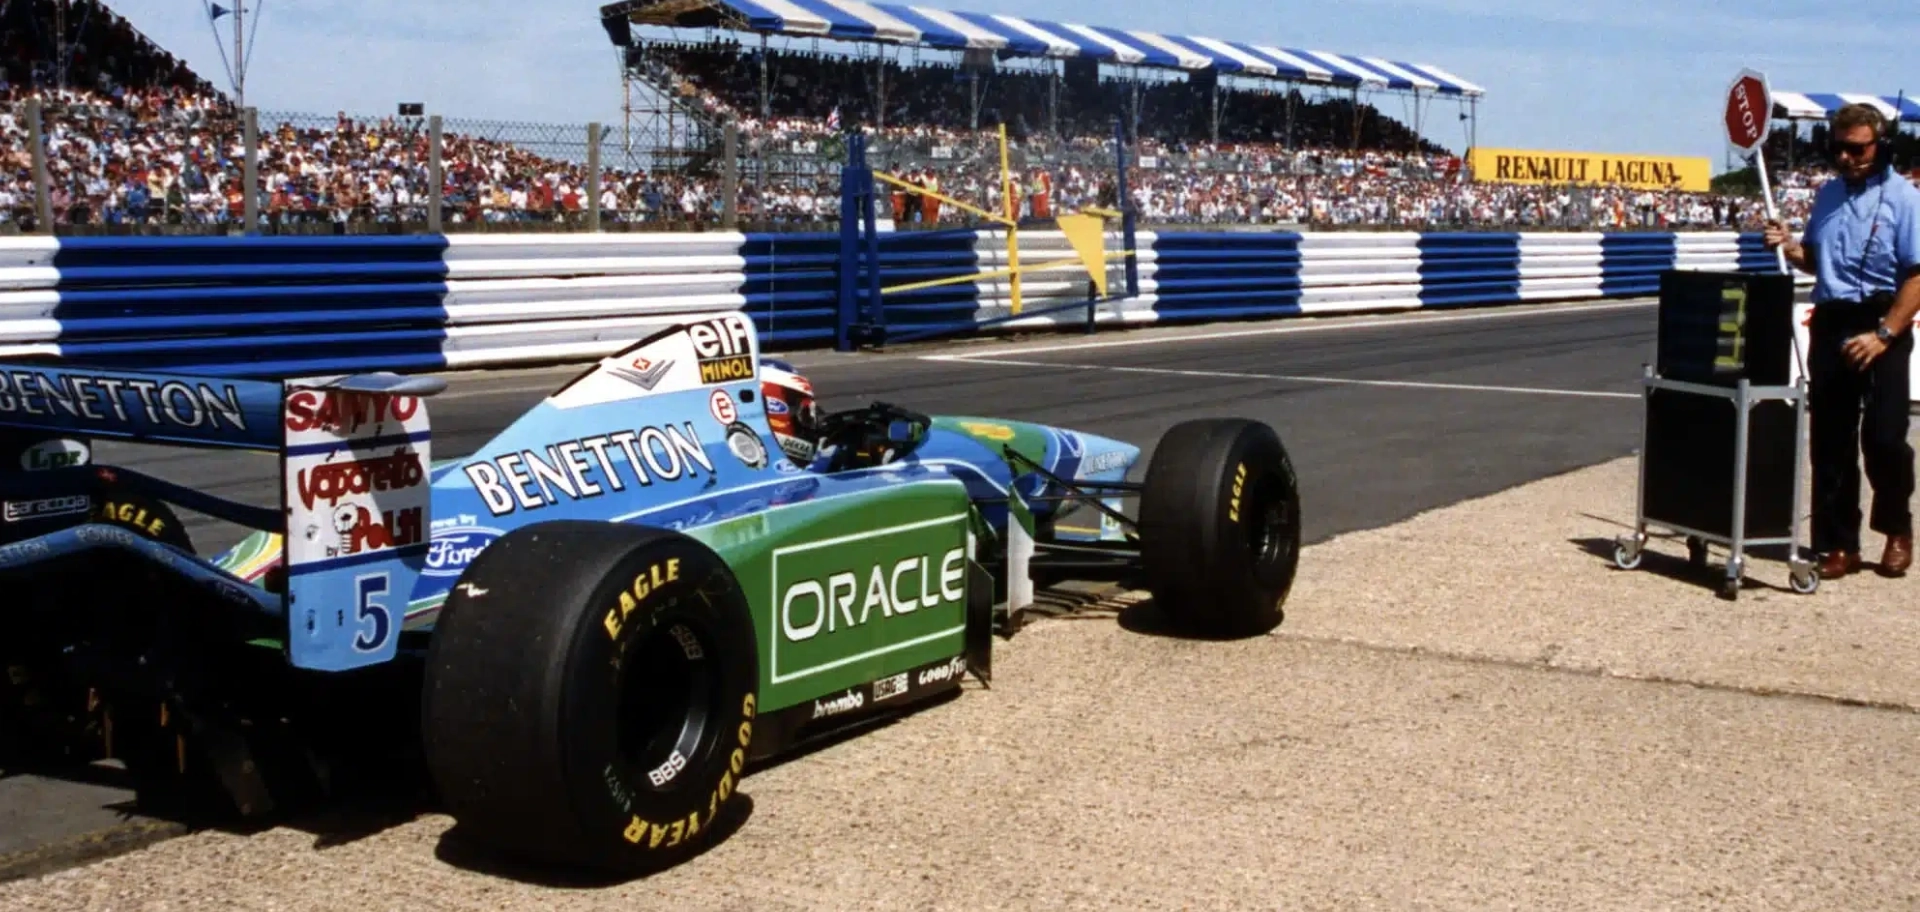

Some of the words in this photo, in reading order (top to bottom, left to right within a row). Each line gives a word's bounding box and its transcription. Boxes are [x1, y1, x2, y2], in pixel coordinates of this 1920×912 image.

[1735, 84, 1758, 138] STOP
[1495, 154, 1589, 182] RENAULT
[1602, 160, 1680, 184] LAGUNA
[690, 317, 746, 357] elf
[700, 358, 752, 382] MINOL
[463, 421, 717, 517] BENETTON
[1228, 461, 1248, 524] EAGLE
[90, 500, 166, 537] AGLE
[351, 571, 393, 655] 5
[603, 557, 681, 641] EAGLE
[782, 547, 965, 642] ORACLE
[812, 688, 864, 720] brembo
[623, 692, 755, 849] GOODYEAR
[648, 749, 687, 787] BBS
